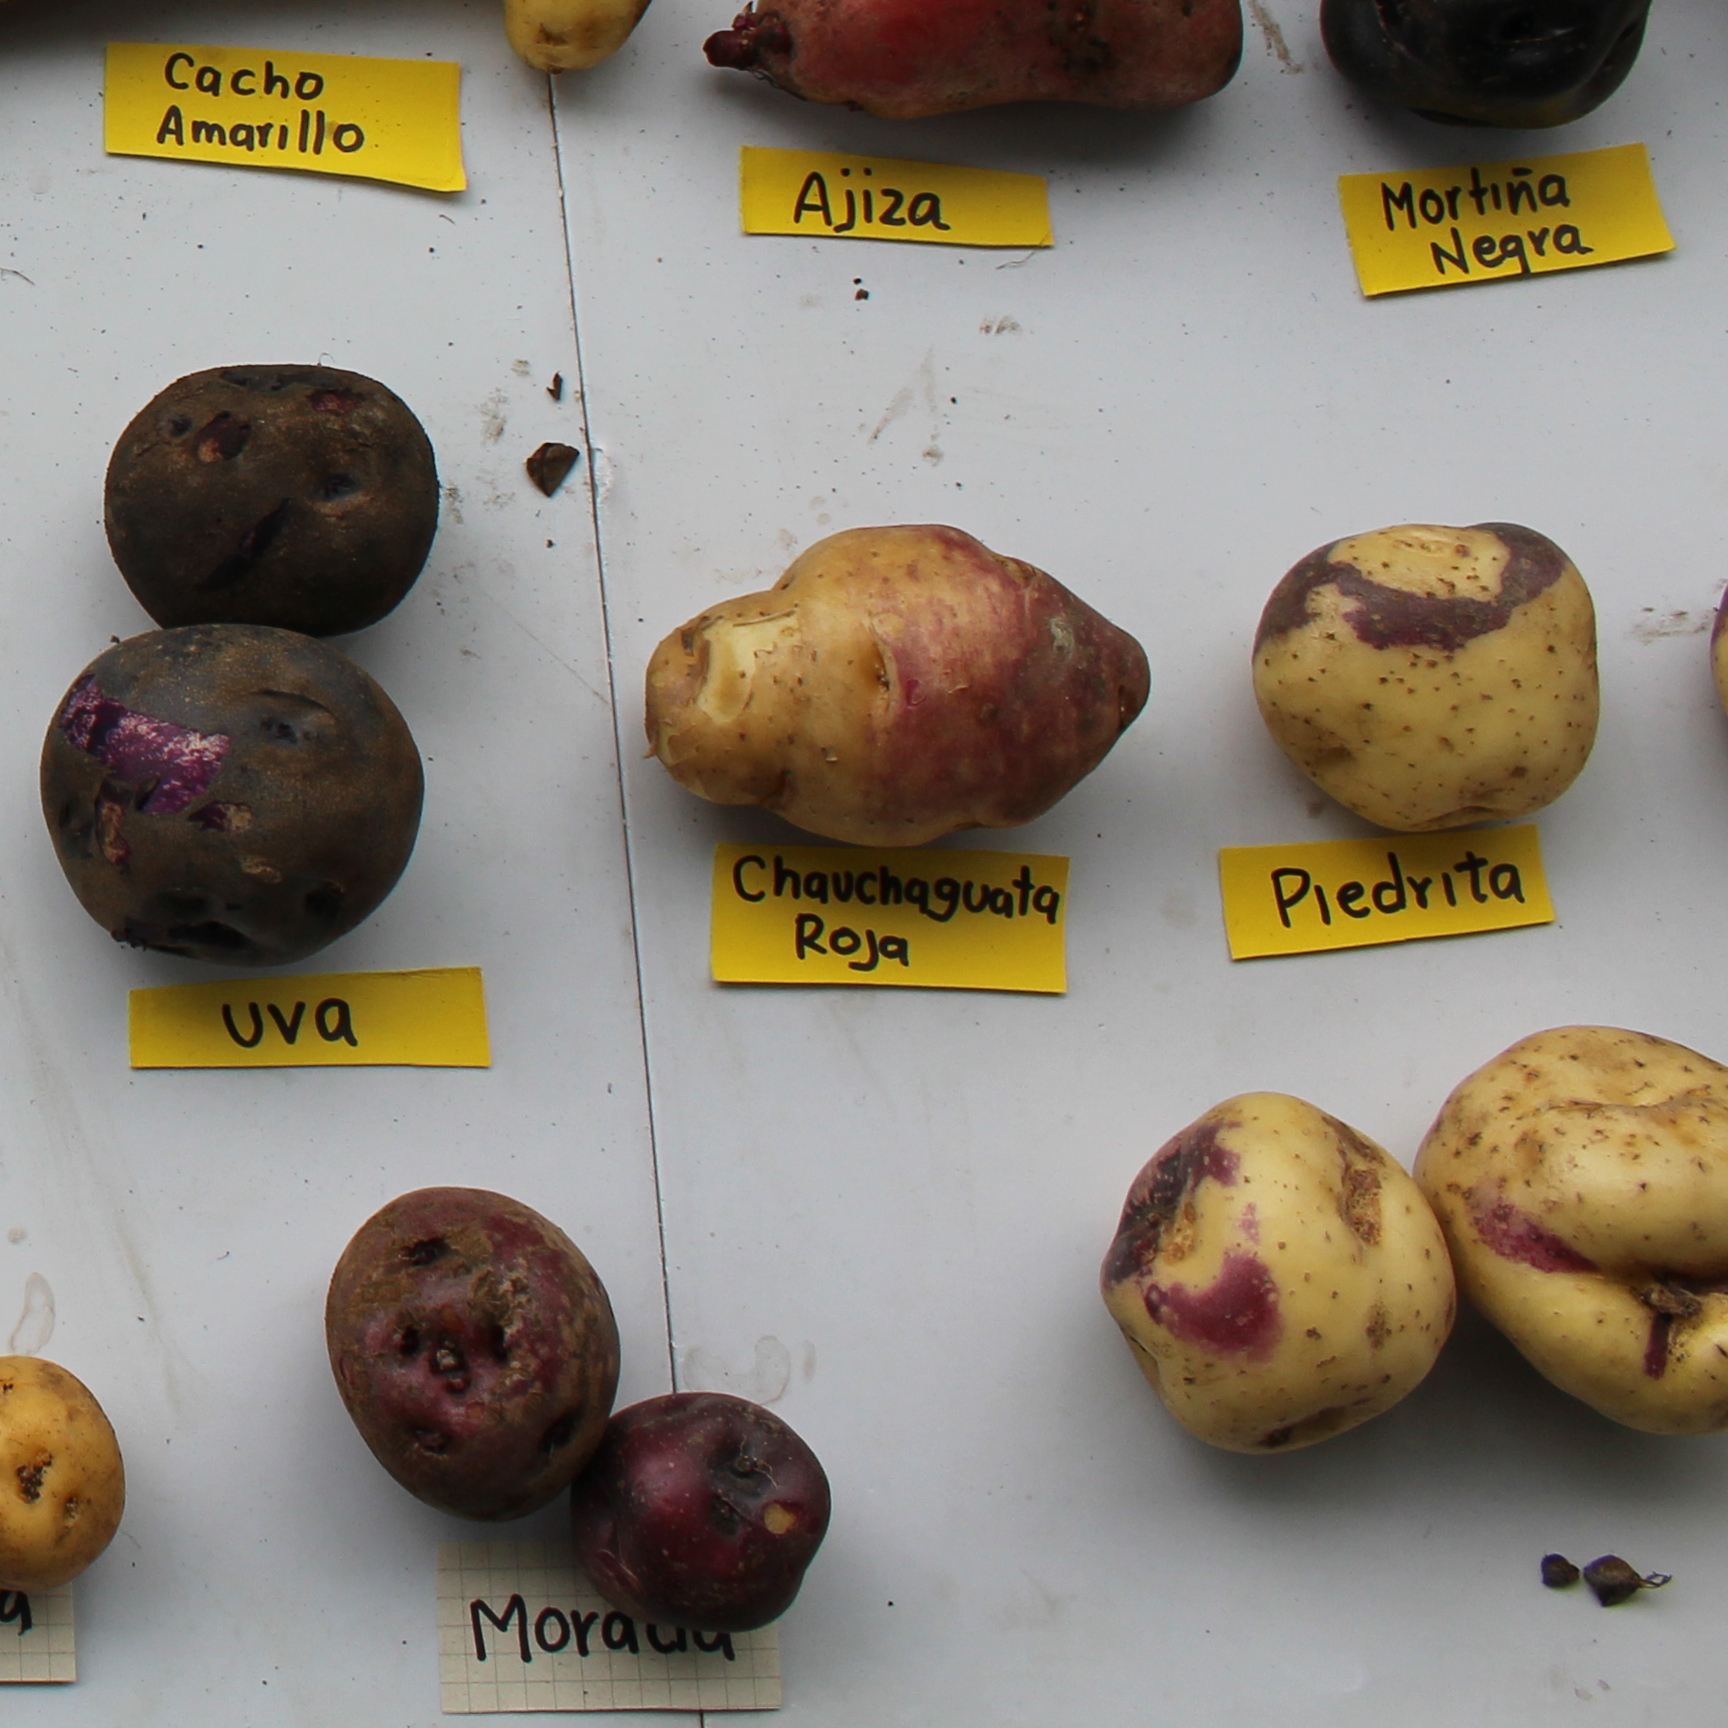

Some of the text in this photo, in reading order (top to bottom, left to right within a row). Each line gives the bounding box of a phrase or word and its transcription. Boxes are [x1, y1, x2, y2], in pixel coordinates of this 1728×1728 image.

[164, 52, 324, 100] Cacho
[157, 106, 365, 154] Amarillo
[793, 166, 952, 233] Ajiza
[1379, 167, 1570, 231] Mortiña
[1429, 219, 1595, 273] Negra
[1271, 850, 1525, 928] Piedrita
